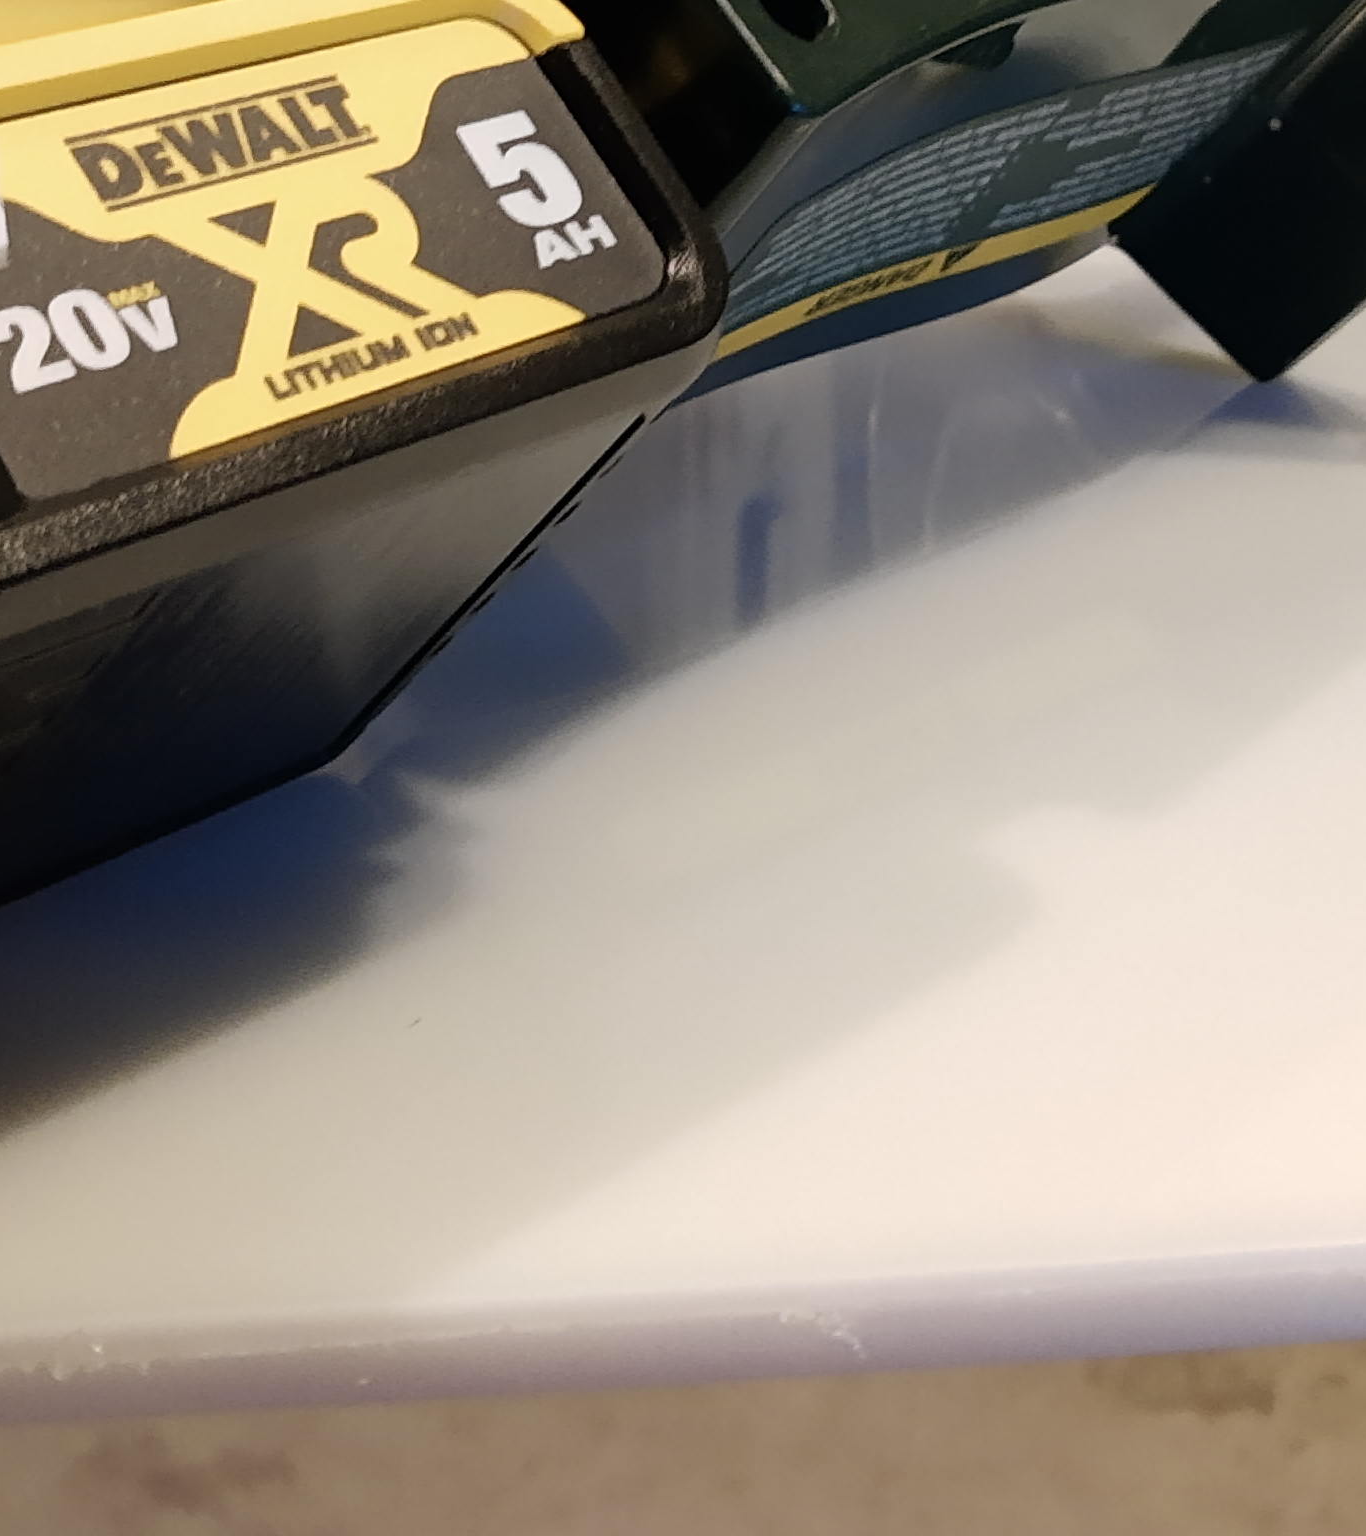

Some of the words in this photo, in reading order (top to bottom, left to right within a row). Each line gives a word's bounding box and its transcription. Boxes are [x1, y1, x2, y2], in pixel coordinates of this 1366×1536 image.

[455, 109, 583, 228] 5
[264, 333, 410, 401] LITHIUM
[416, 311, 479, 354] ION
